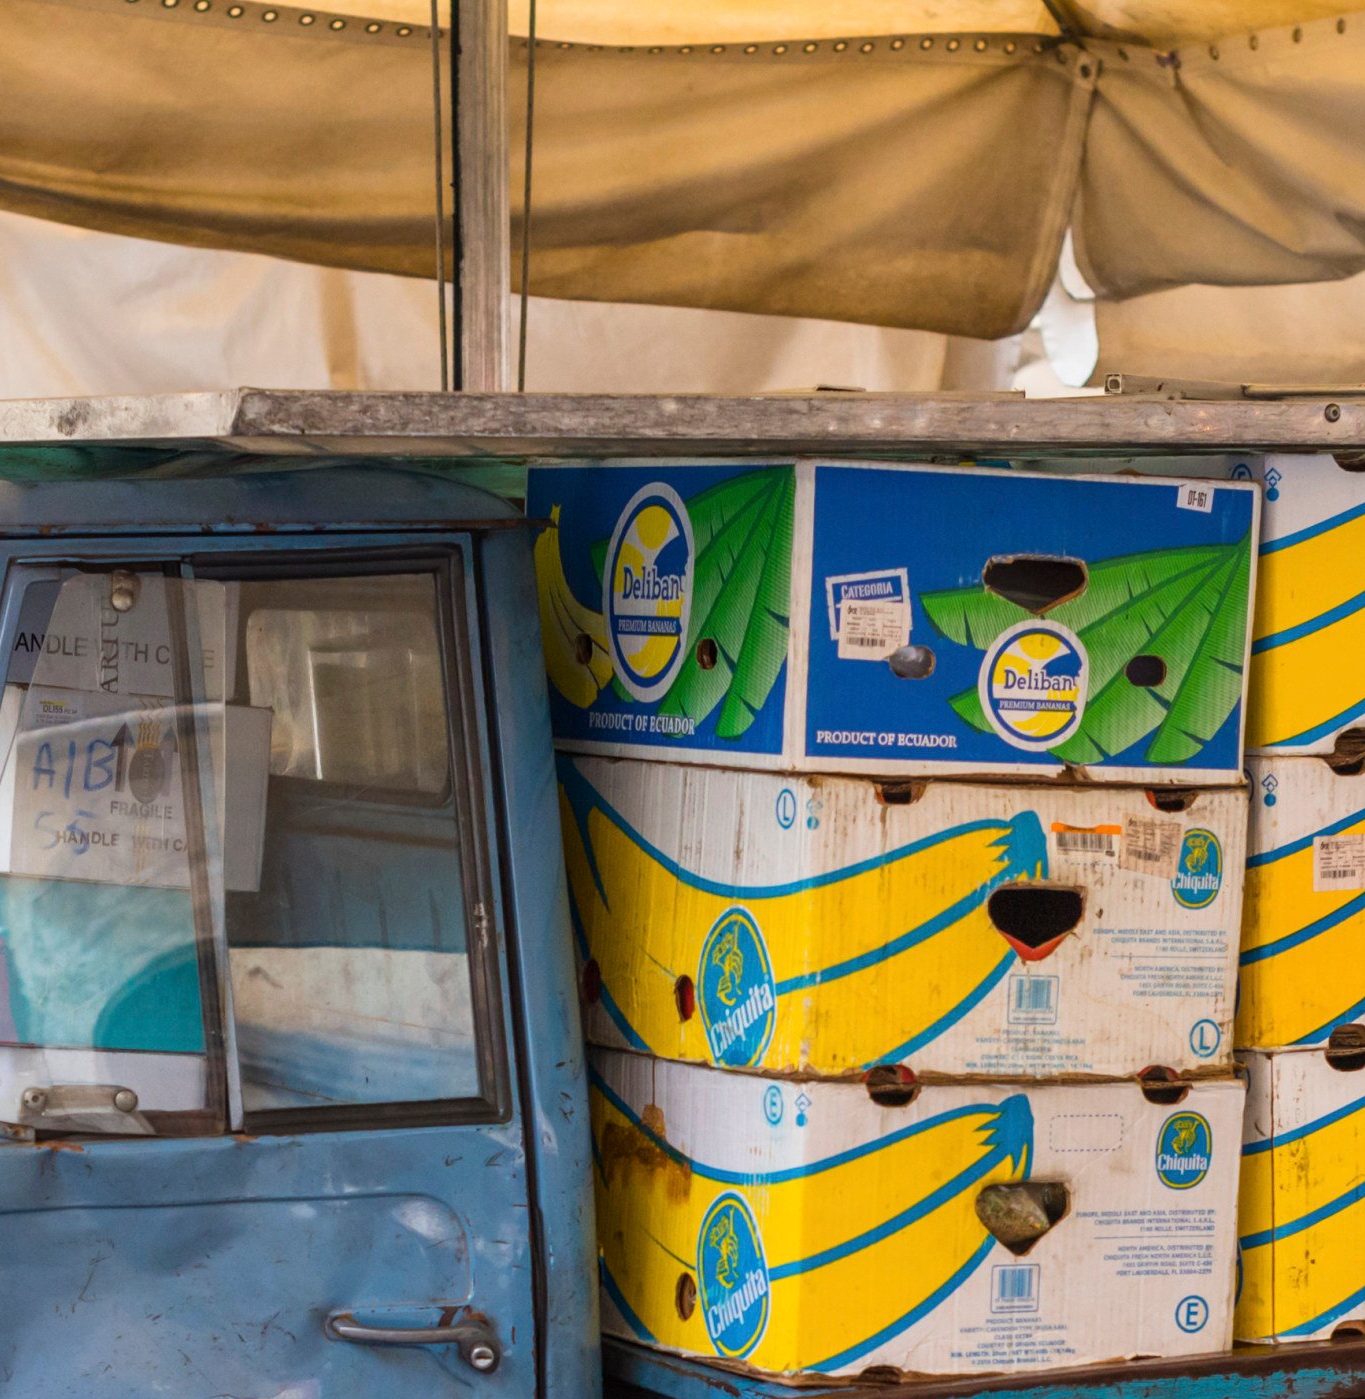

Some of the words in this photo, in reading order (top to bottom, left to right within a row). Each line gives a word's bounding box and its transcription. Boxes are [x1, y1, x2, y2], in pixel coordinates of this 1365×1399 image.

[622, 565, 682, 601] Deliban
[841, 581, 893, 599] CATEGORIA
[618, 619, 647, 632] PREMIUM
[647, 620, 677, 633] BANANAS
[1003, 669, 1077, 691] Deliban
[999, 700, 1035, 710] PREMIUM
[1036, 700, 1071, 711] BANANAS
[589, 712, 634, 731] PRODUCT
[635, 715, 648, 732] OF
[649, 716, 695, 736] ECUADOR
[816, 730, 876, 747] PRODUCT
[877, 732, 896, 747] OF
[897, 732, 958, 748] ECUADOR
[110, 801, 173, 820] FRAGILE
[56, 830, 120, 847] HANDLE
[1172, 873, 1220, 894] Chiquita
[710, 982, 773, 1059] Chiquita
[1157, 1153, 1209, 1175] Chiquita
[708, 1268, 768, 1340] Chiquita
